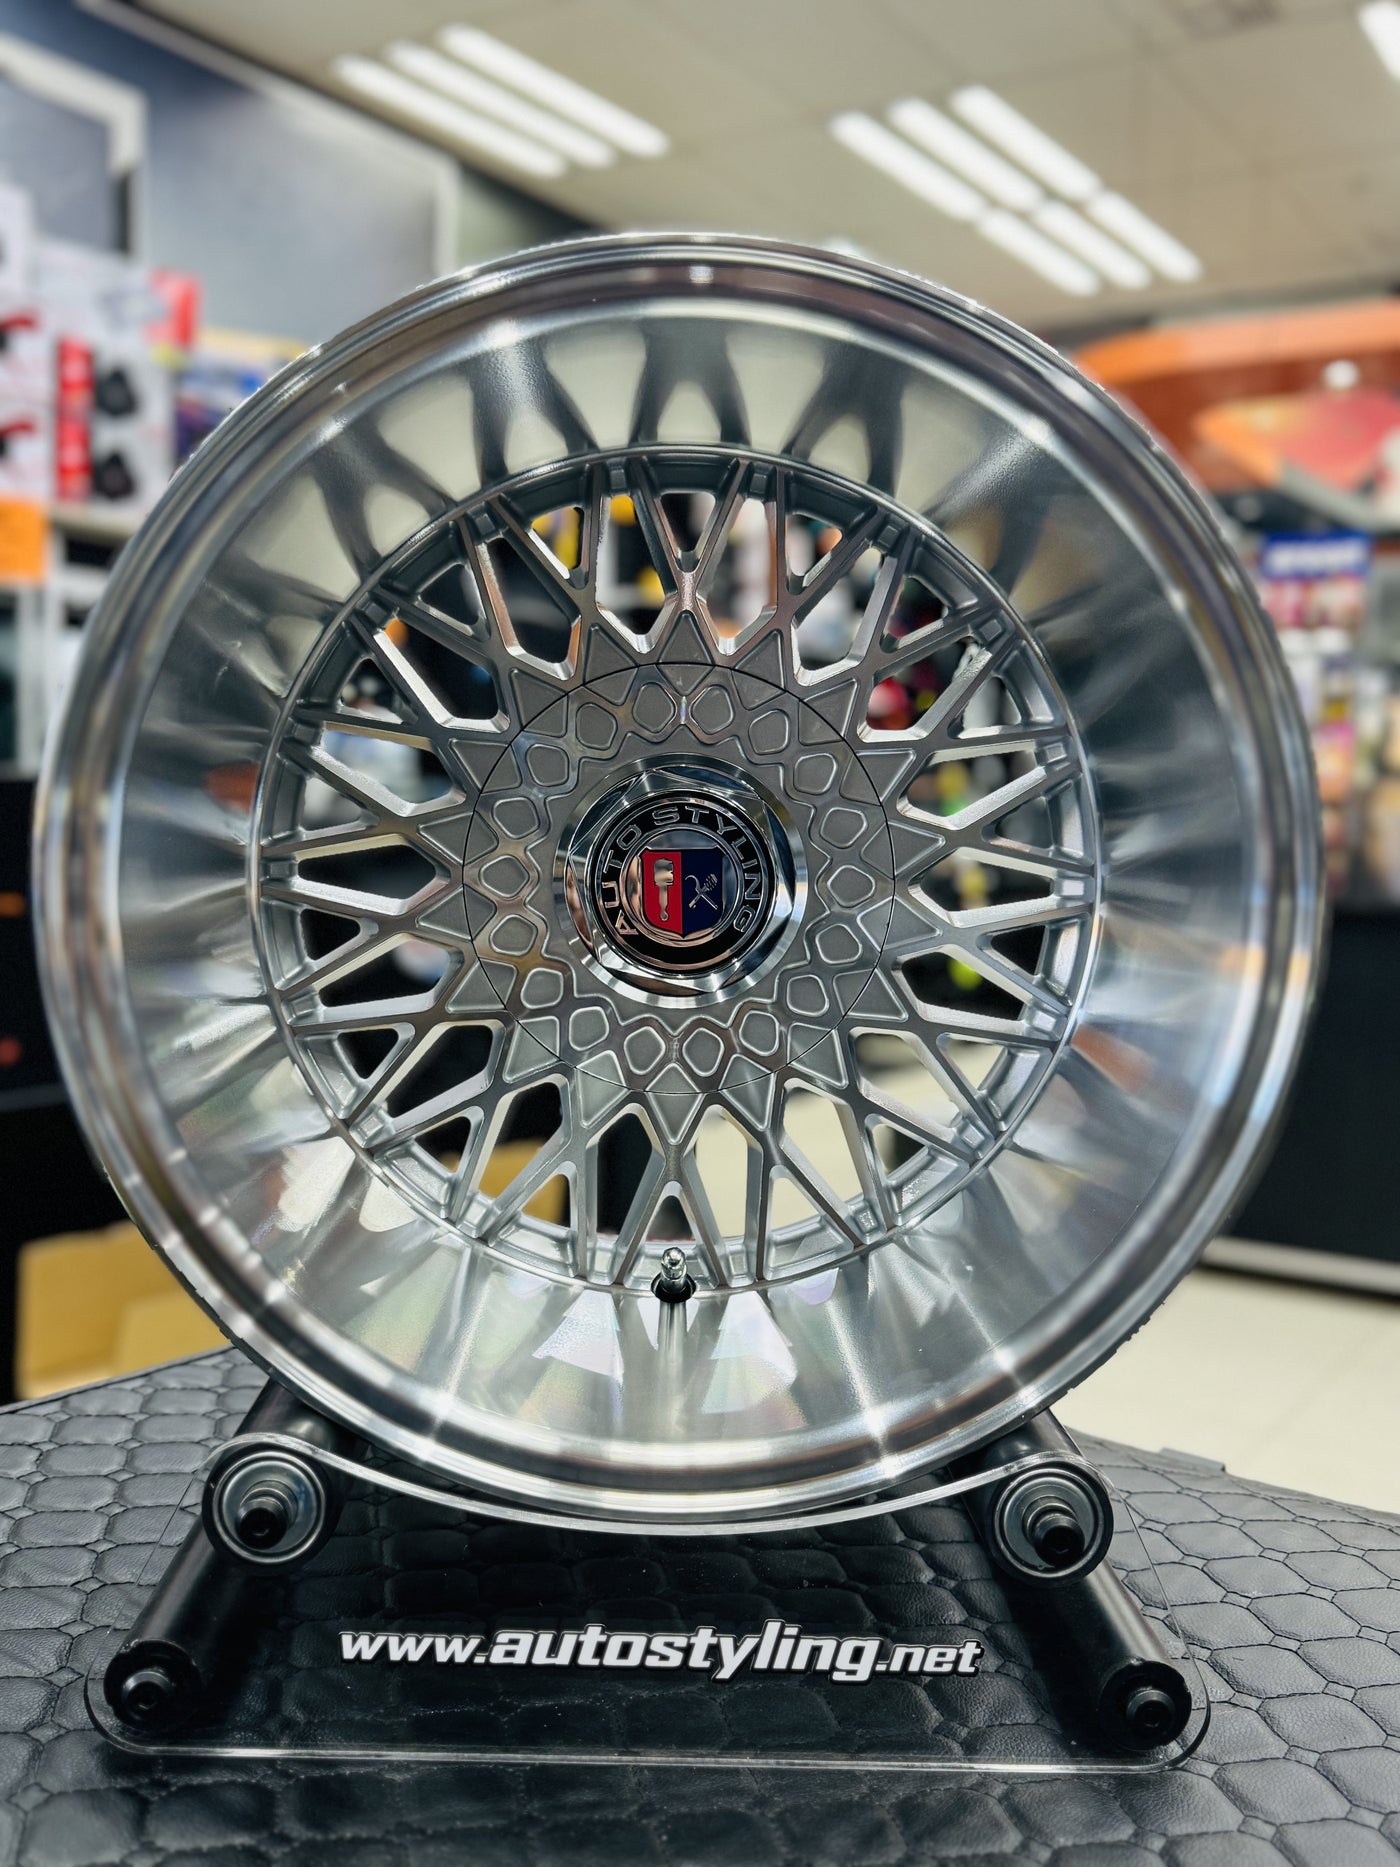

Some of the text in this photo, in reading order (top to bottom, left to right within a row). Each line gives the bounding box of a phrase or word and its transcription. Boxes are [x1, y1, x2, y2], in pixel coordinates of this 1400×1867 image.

[601, 805, 761, 936] AUTO STYLING
[339, 1619, 984, 1682] www.autostyling.net
